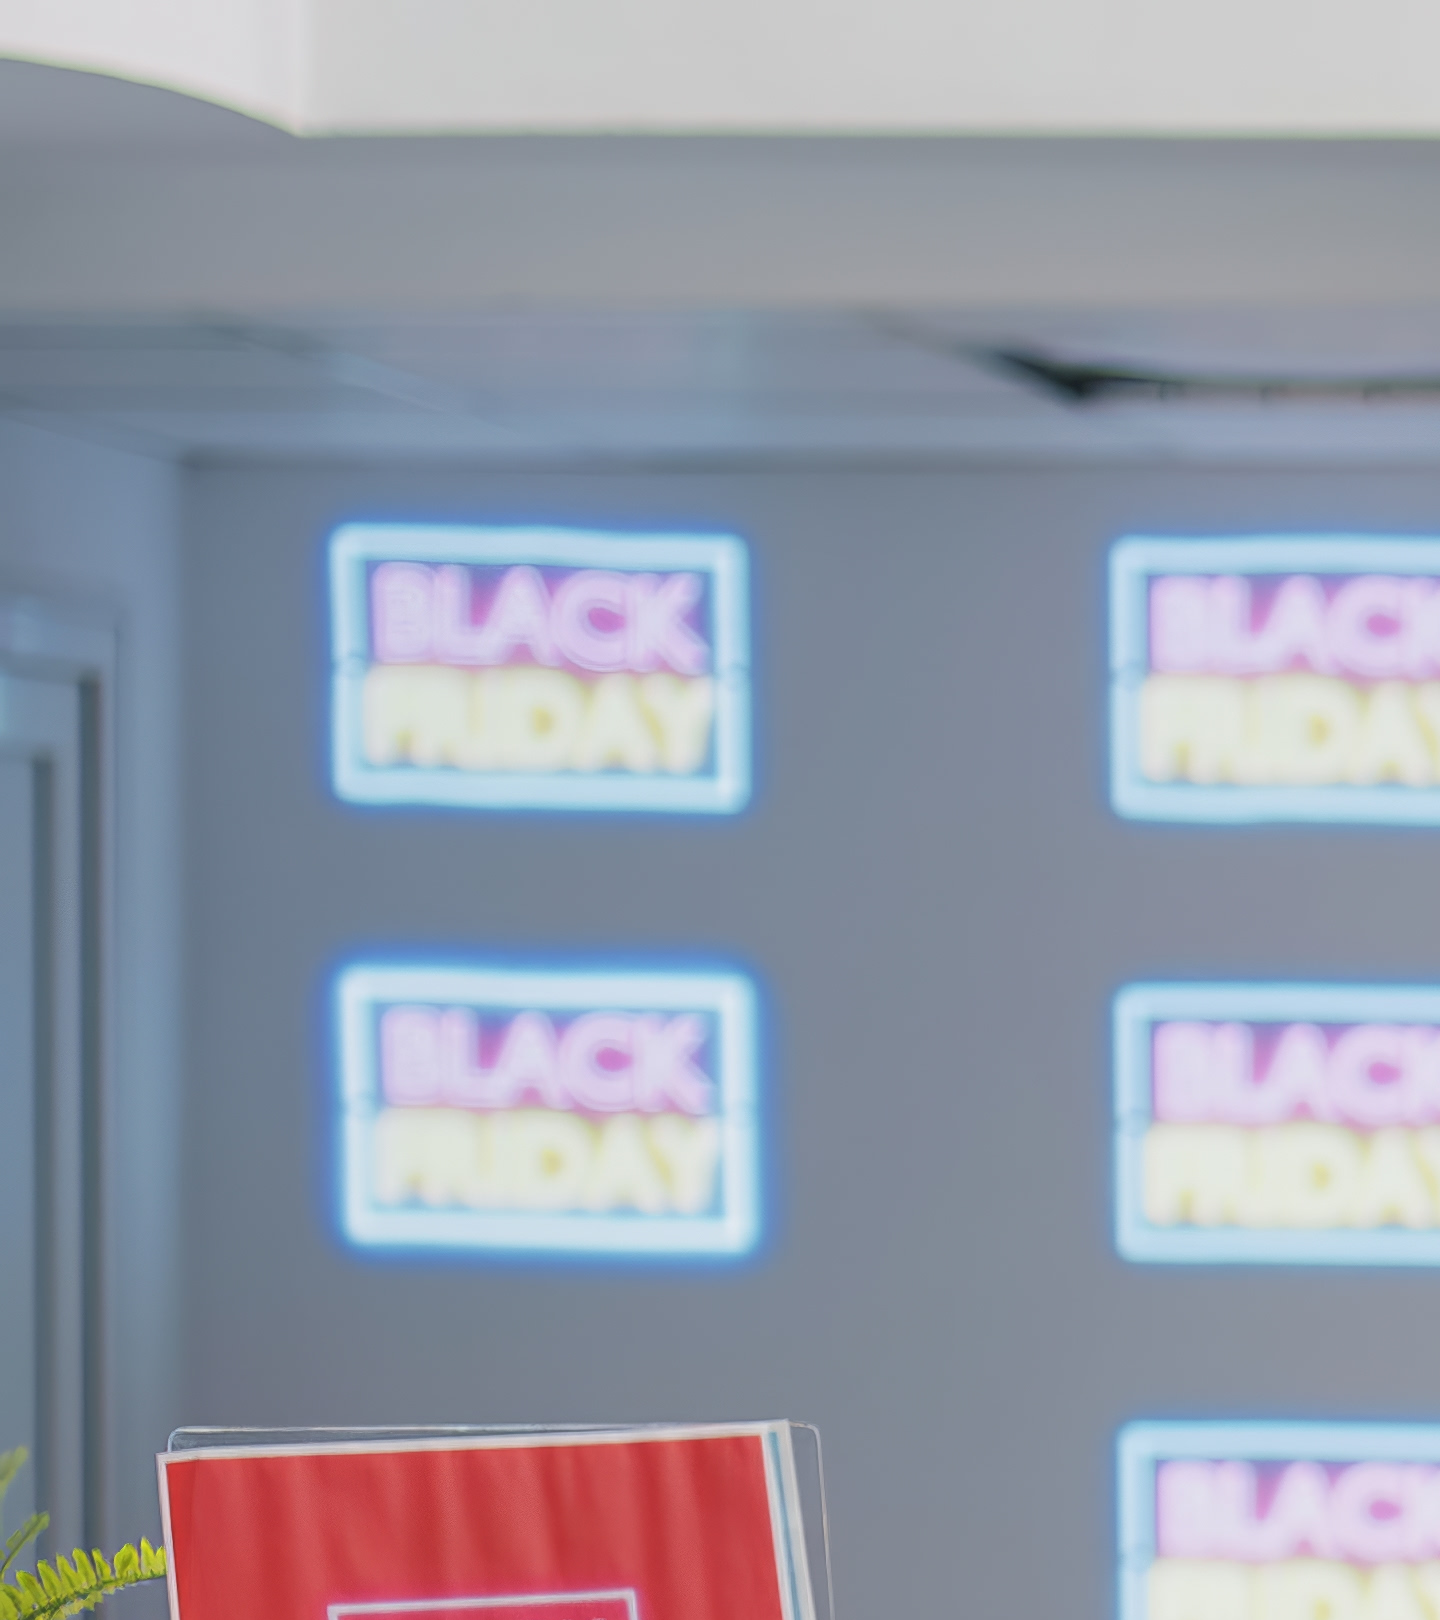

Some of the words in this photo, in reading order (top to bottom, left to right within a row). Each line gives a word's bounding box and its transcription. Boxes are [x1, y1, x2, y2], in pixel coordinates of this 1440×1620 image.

[372, 561, 713, 676] BLACK
[363, 664, 714, 775] FRIDAY
[381, 1005, 716, 1115] BLACK
[374, 1108, 721, 1214] FRIDAY
